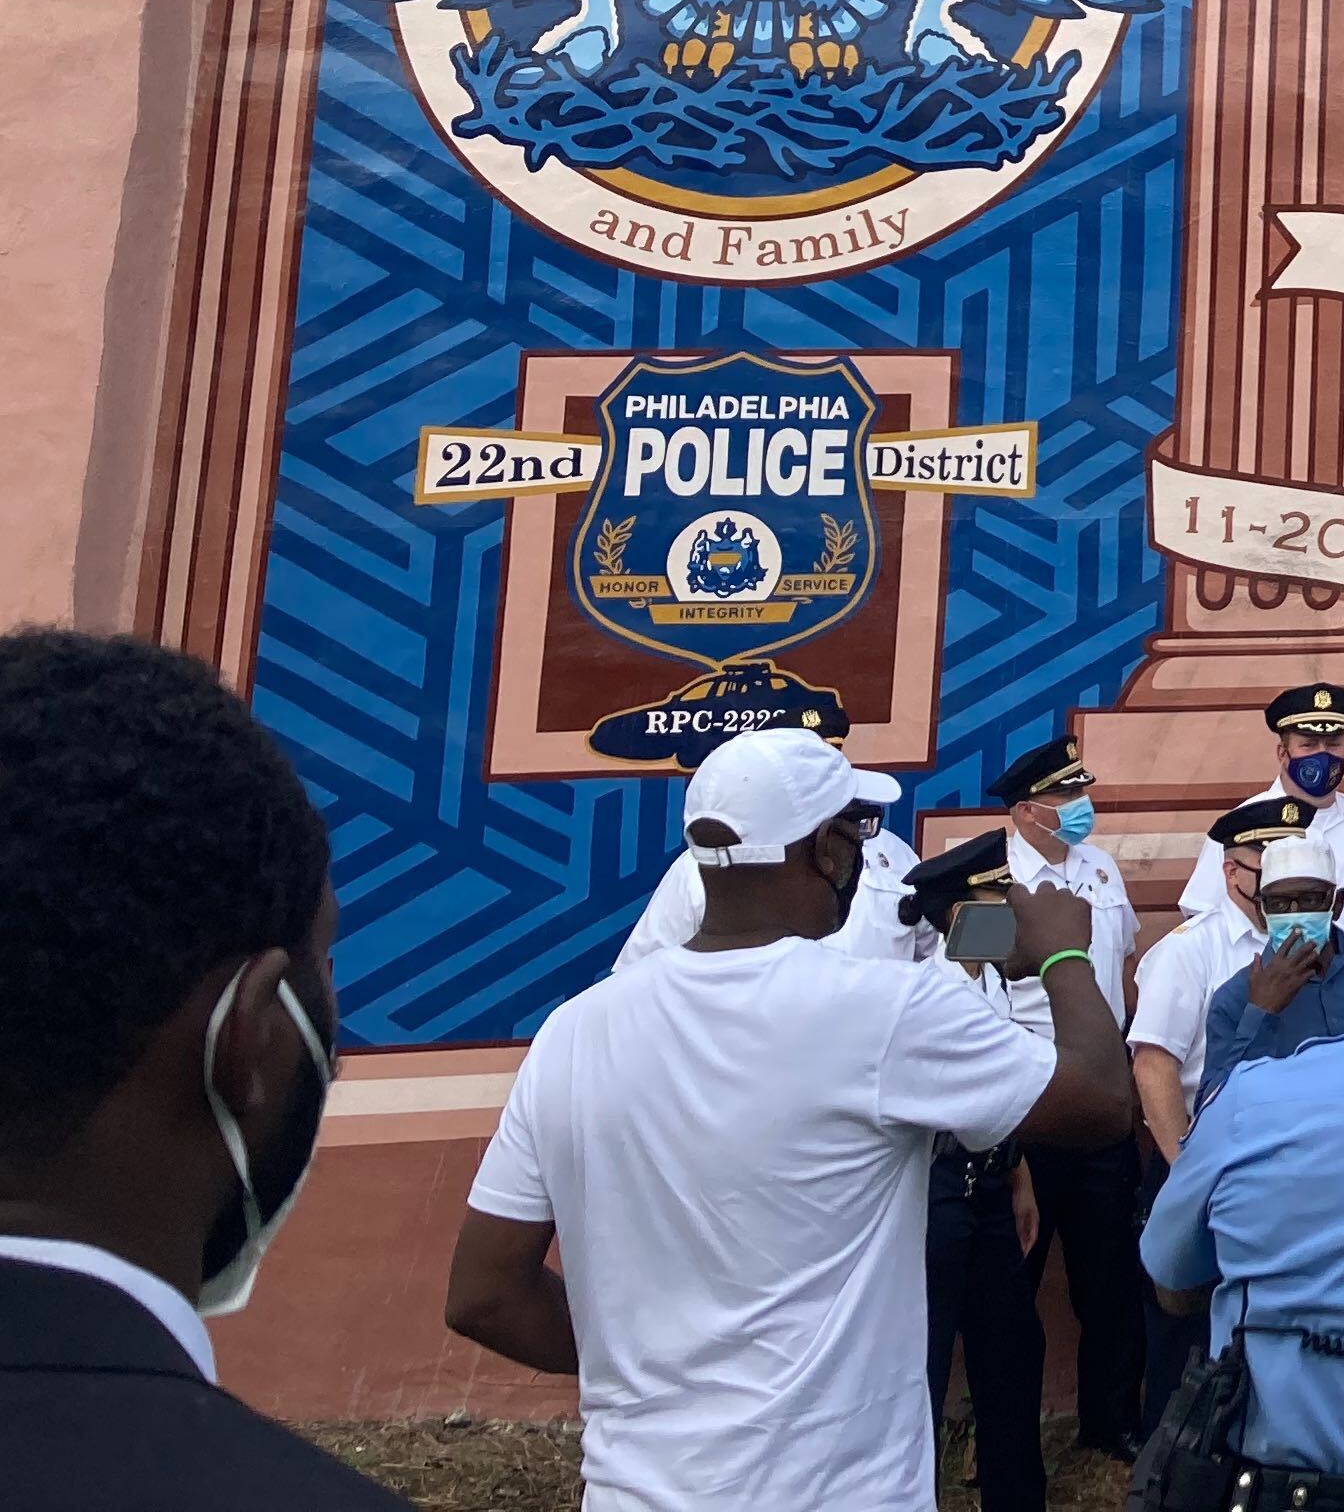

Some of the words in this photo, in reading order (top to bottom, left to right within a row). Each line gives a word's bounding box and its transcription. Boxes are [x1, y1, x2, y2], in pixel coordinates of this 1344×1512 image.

[589, 198, 696, 266] and
[712, 200, 912, 270] Family
[624, 393, 850, 420] PHILADELPHIA
[437, 441, 585, 488] 22nd
[623, 427, 849, 497] POLICE
[871, 438, 1023, 485] District
[600, 580, 659, 593] HONOR
[782, 578, 849, 592] SERVICE
[679, 606, 765, 620] INTEGRITY
